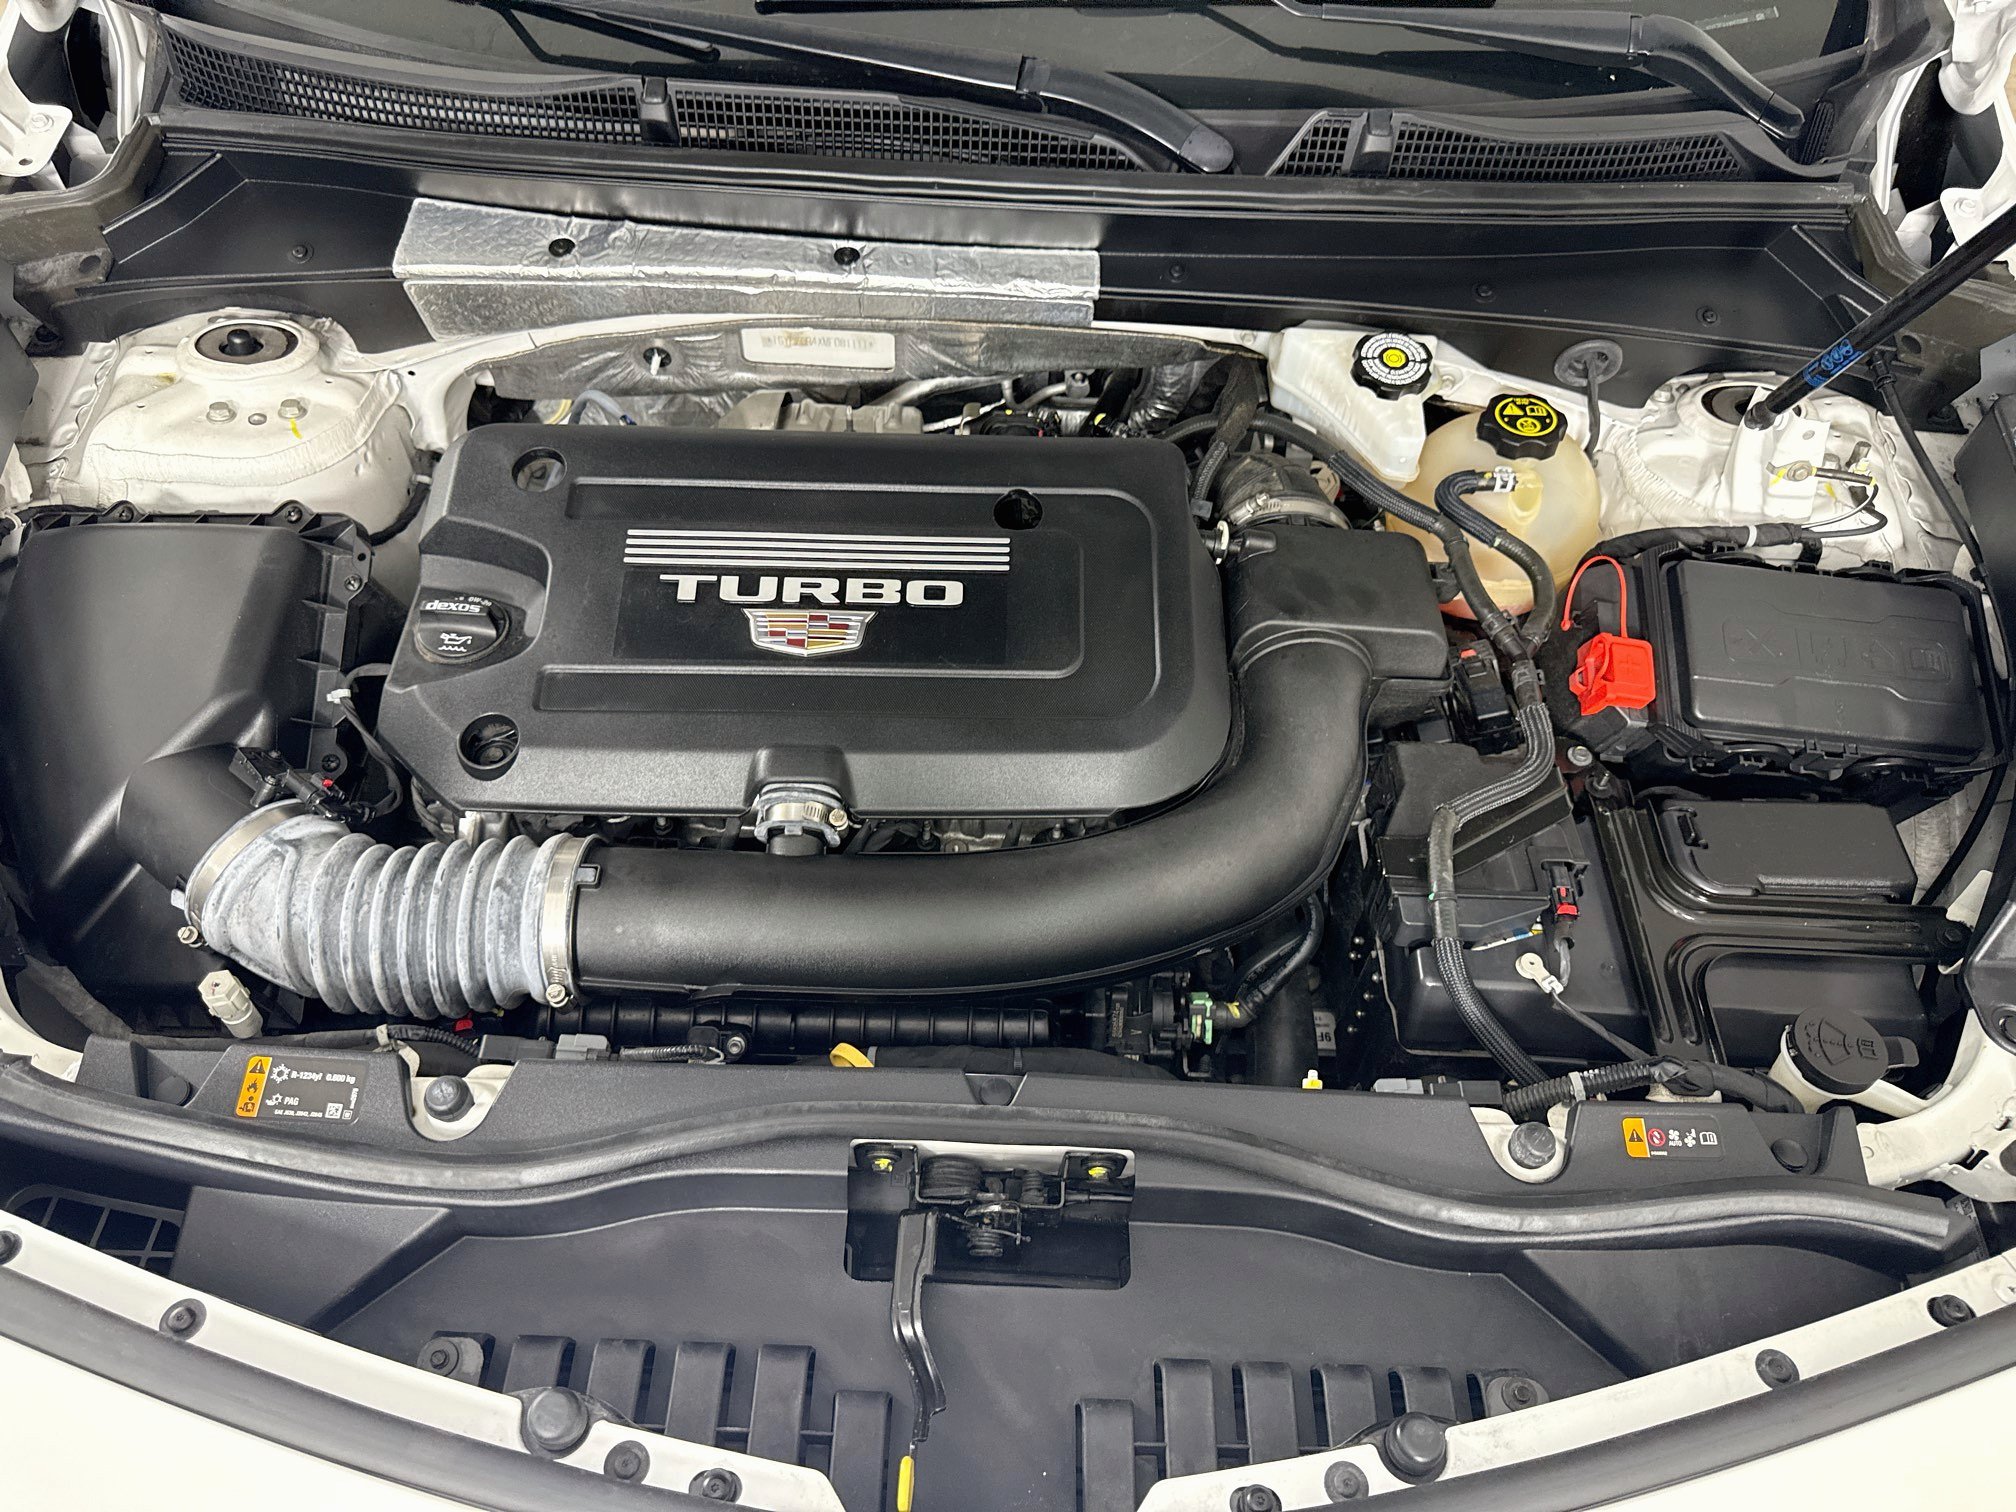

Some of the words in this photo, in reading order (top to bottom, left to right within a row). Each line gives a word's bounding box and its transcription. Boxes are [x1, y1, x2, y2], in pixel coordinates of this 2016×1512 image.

[659, 574, 964, 607] TURBO
[425, 600, 481, 613] dexos
[346, 1075, 356, 1084] kg
[284, 1096, 299, 1106] PAG
